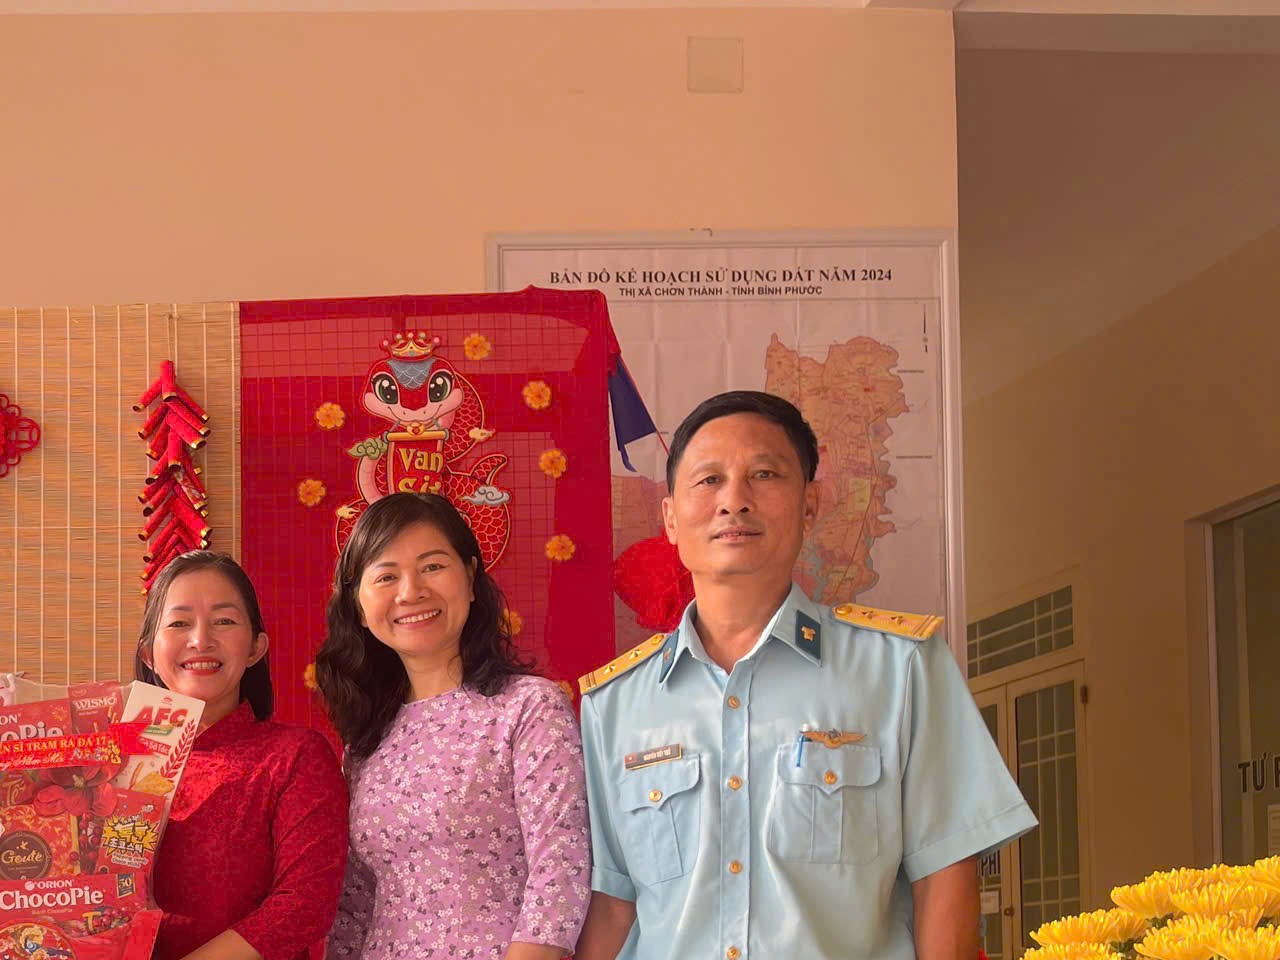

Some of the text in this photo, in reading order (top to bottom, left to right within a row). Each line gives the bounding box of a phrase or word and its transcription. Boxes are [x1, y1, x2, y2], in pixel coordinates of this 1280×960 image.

[550, 267, 892, 286] BẢN ĐỒ KẾ HOẠCH SỬ DỤNG ĐẤT NĂM 2024
[620, 287, 636, 298] THỊ
[638, 286, 652, 296] XÃ
[655, 287, 685, 296] CHƠN
[689, 286, 722, 296] THÀNH
[757, 286, 782, 295] BÌNH
[785, 285, 823, 295] PHƯỚC
[131, 706, 188, 727] AFC
[37, 879, 73, 889] ORION
[118, 878, 132, 888] 50
